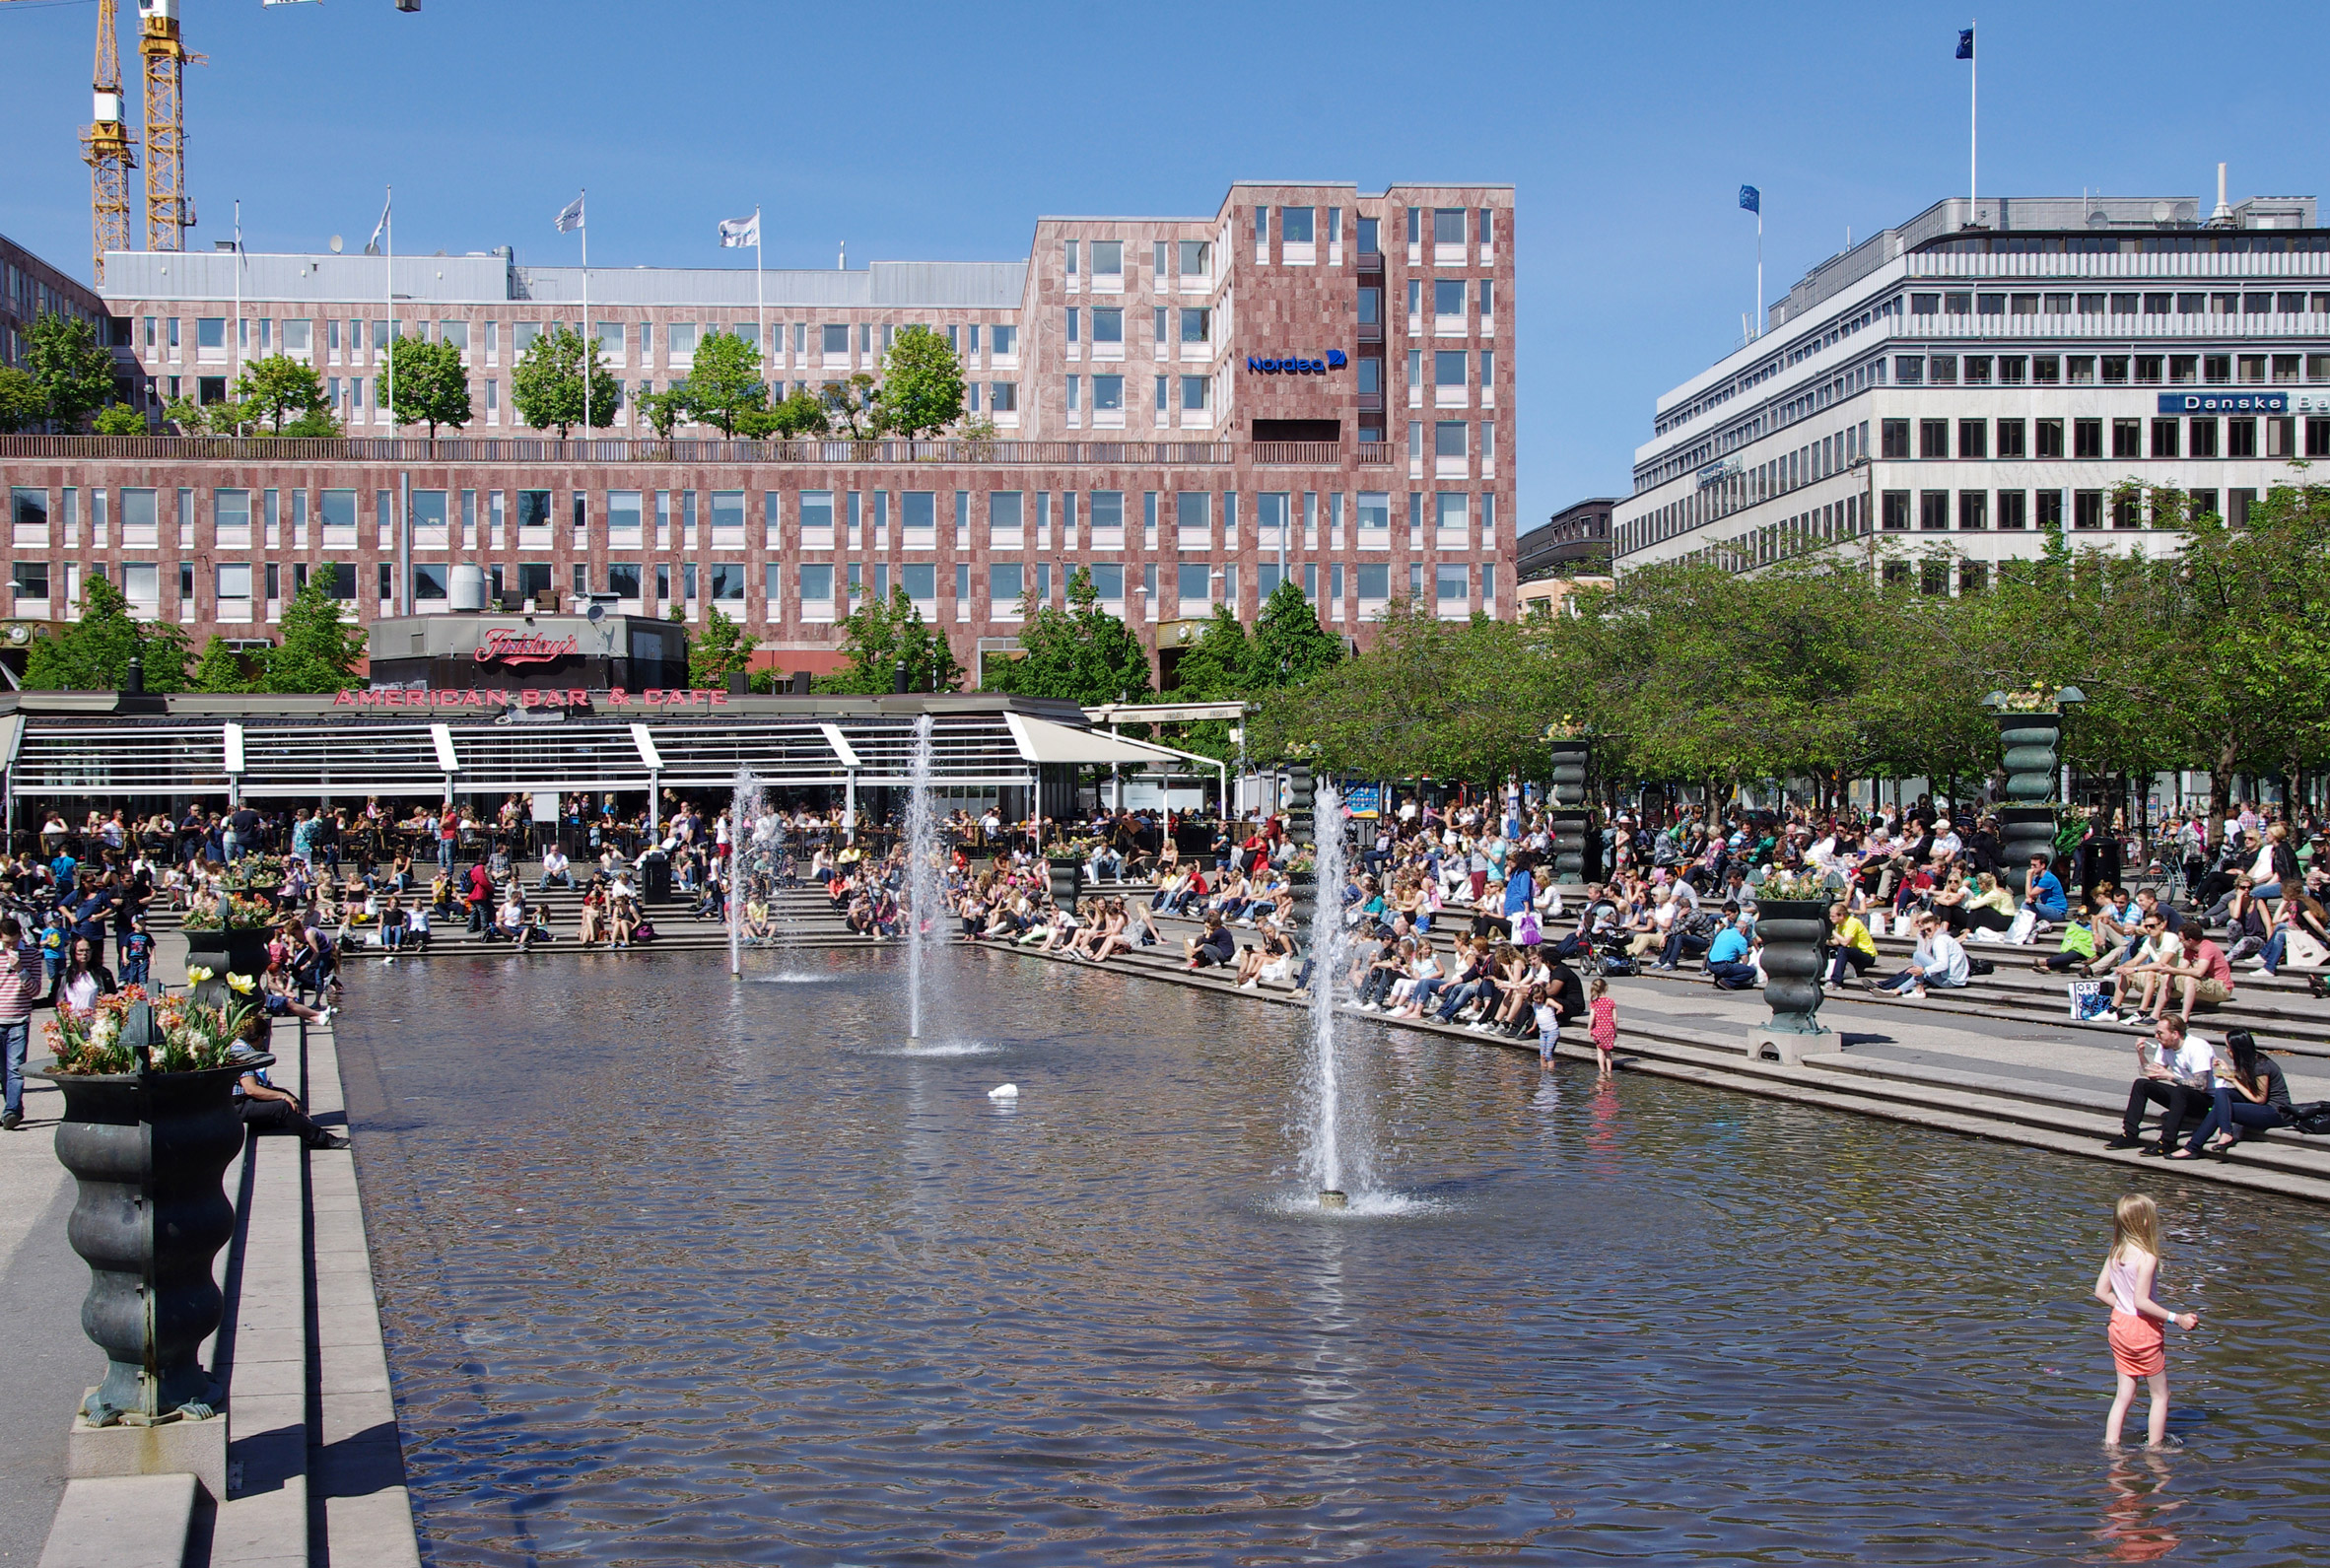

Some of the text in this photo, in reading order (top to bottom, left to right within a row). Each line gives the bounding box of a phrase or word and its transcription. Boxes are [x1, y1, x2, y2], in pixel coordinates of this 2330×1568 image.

[1247, 356, 1325, 372] Nordea
[2184, 395, 2282, 410] Danske
[333, 686, 728, 707] AMERICAN BAR & CAFE
